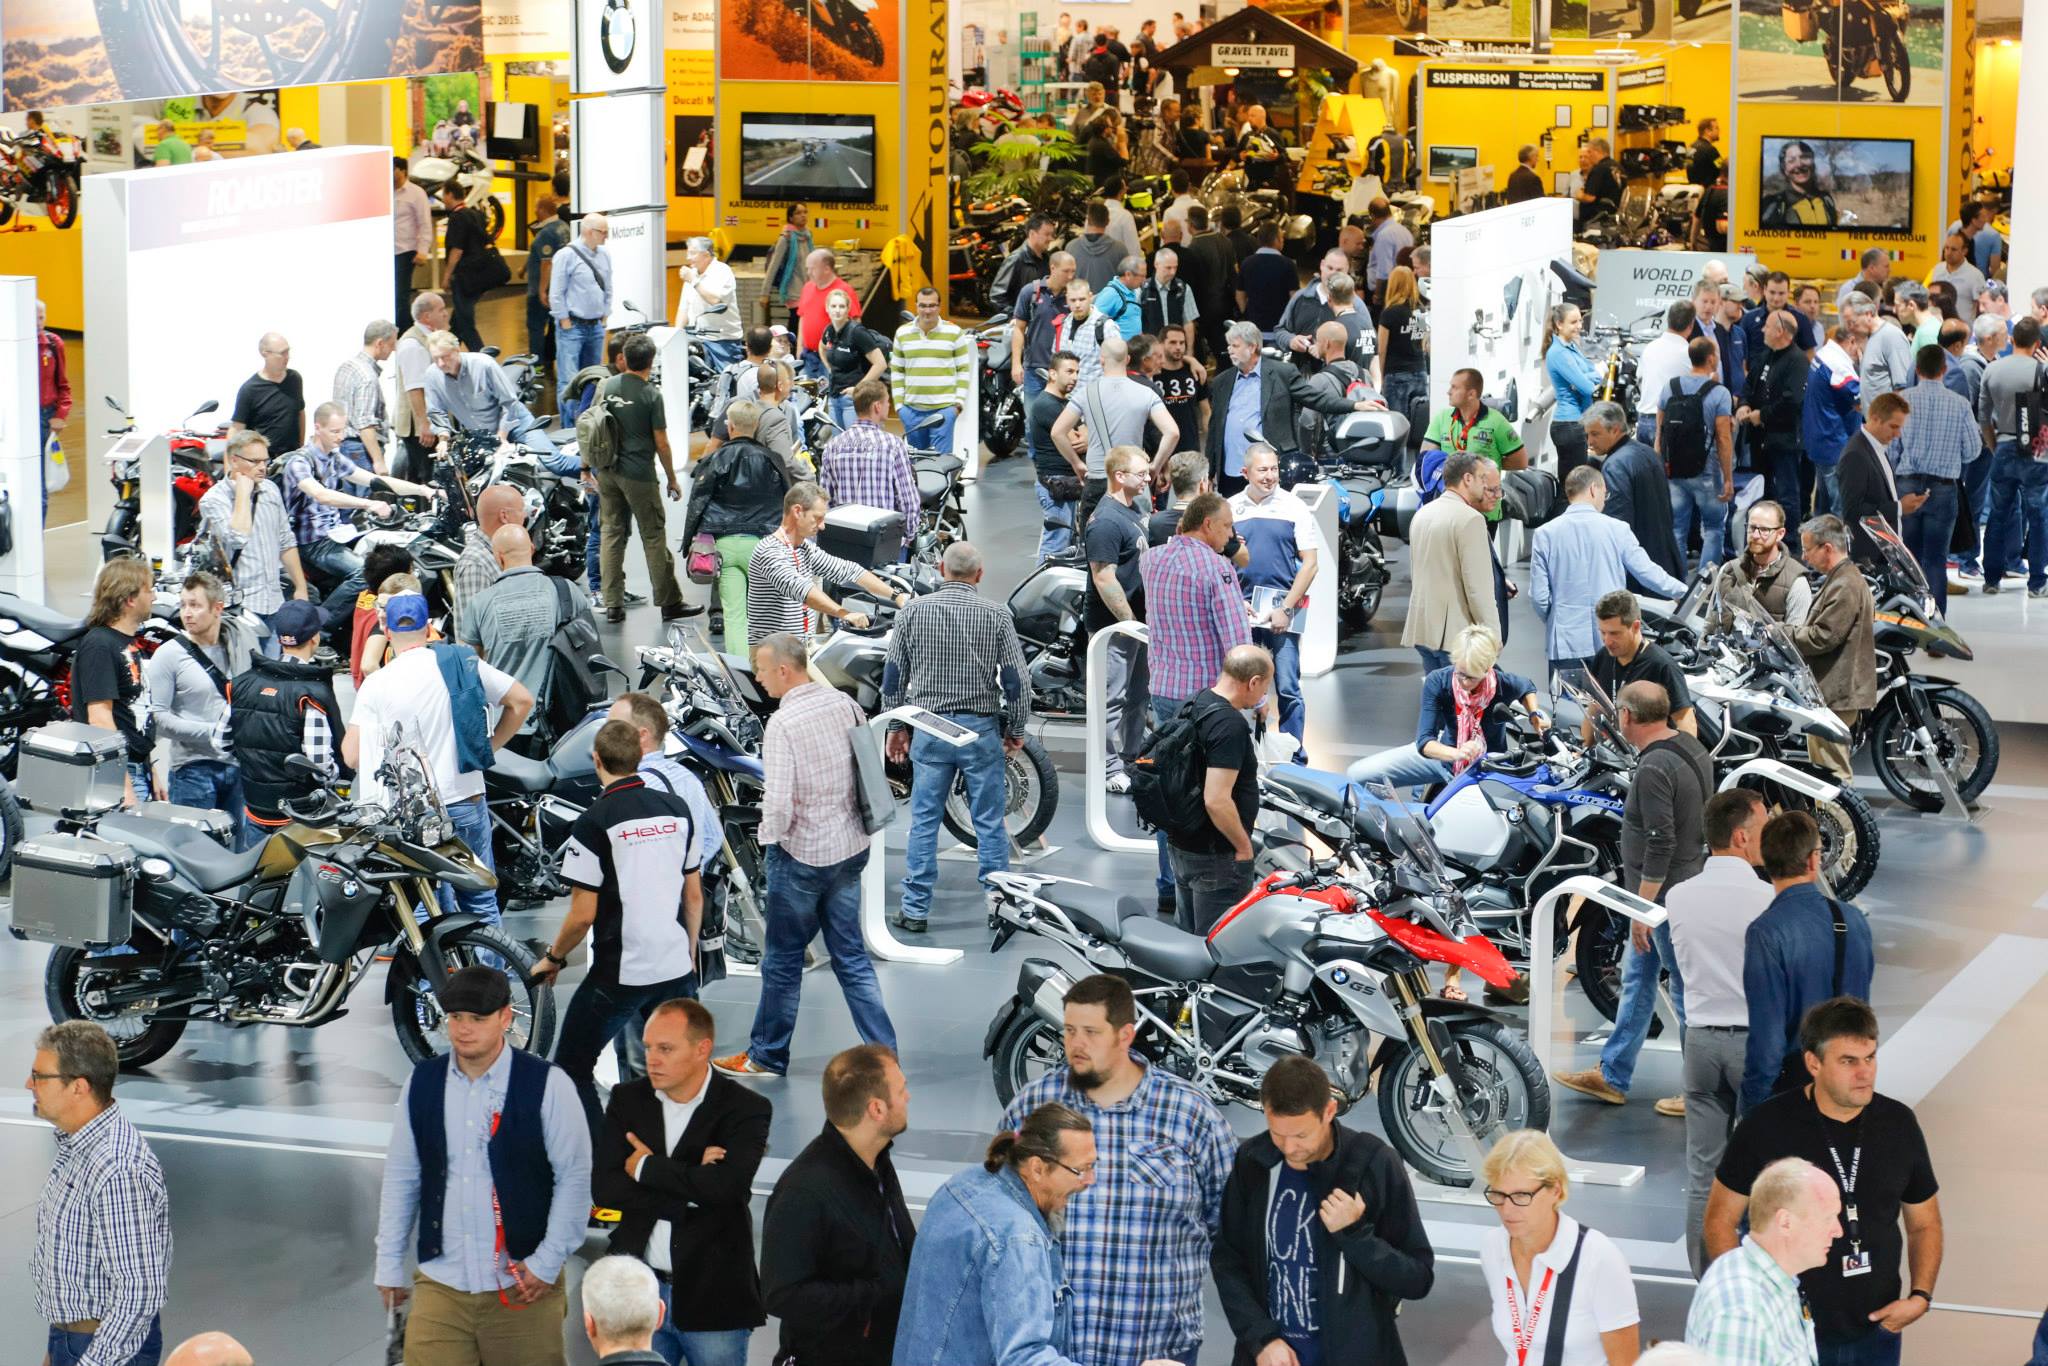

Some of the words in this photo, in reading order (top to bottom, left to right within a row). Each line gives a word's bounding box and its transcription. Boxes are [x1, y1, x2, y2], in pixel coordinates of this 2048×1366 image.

[673, 12, 688, 22] Der
[1217, 46, 1252, 56] GRAVEL
[1255, 47, 1289, 57] TRAVEL
[1432, 71, 1510, 86] SUSPENSION
[673, 95, 704, 105] Ducati
[208, 168, 323, 216] ROADSTER
[729, 200, 771, 209] KATALOGE
[773, 201, 807, 209] GRAS
[821, 202, 841, 211] FREE
[841, 203, 889, 212] CATALOGUE
[611, 223, 645, 241] Motorrad
[1743, 230, 1792, 239] KATALOGE
[1794, 231, 1827, 241] GRATIS
[1848, 232, 1869, 241] FREE
[1871, 233, 1927, 243] CATALOGUE
[1633, 267, 1693, 282] WORLD
[1655, 284, 1693, 297] PRE
[1155, 377, 1196, 397] 333
[618, 822, 677, 841] Held
[1349, 981, 1377, 996] GS
[1266, 1188, 1316, 1264] CK
[1522, 1308, 1541, 1350] INTERMOT
